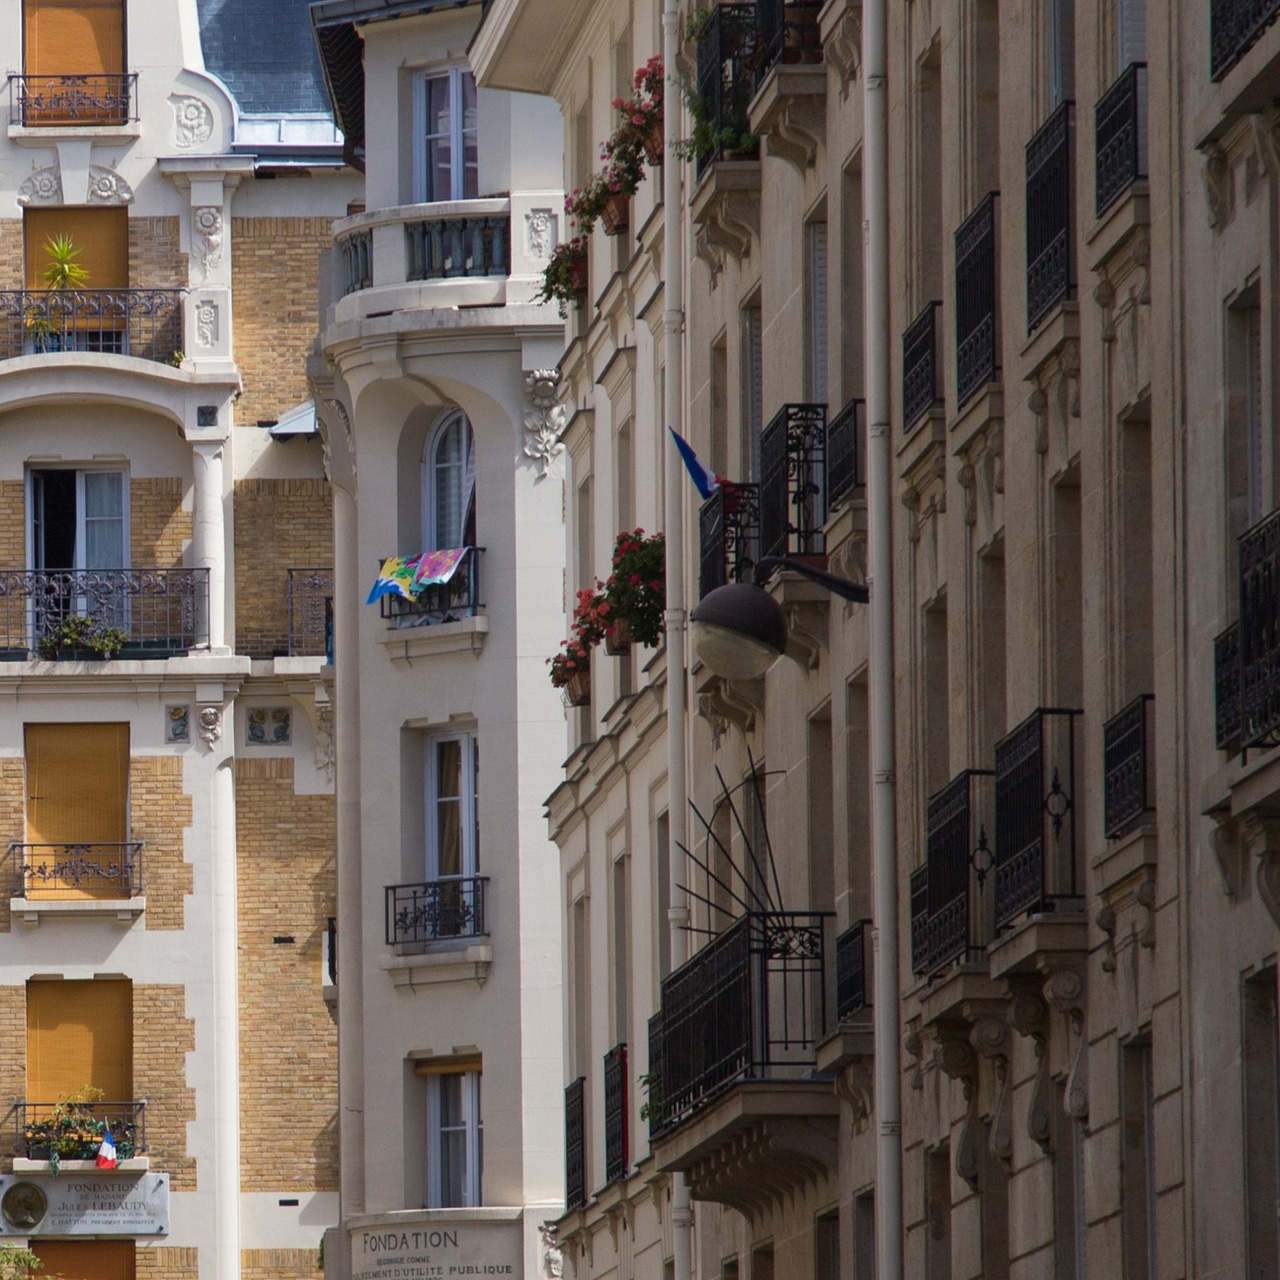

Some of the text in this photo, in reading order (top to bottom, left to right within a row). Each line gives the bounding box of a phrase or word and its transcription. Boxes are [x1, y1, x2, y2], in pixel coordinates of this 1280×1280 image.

[68, 1183, 139, 1193] FONDATION
[58, 1202, 148, 1211] JULES LEBAUDY
[363, 1231, 459, 1254] FONDATION
[406, 1256, 431, 1264] COMME
[449, 1265, 513, 1276] PUBLIQUE
